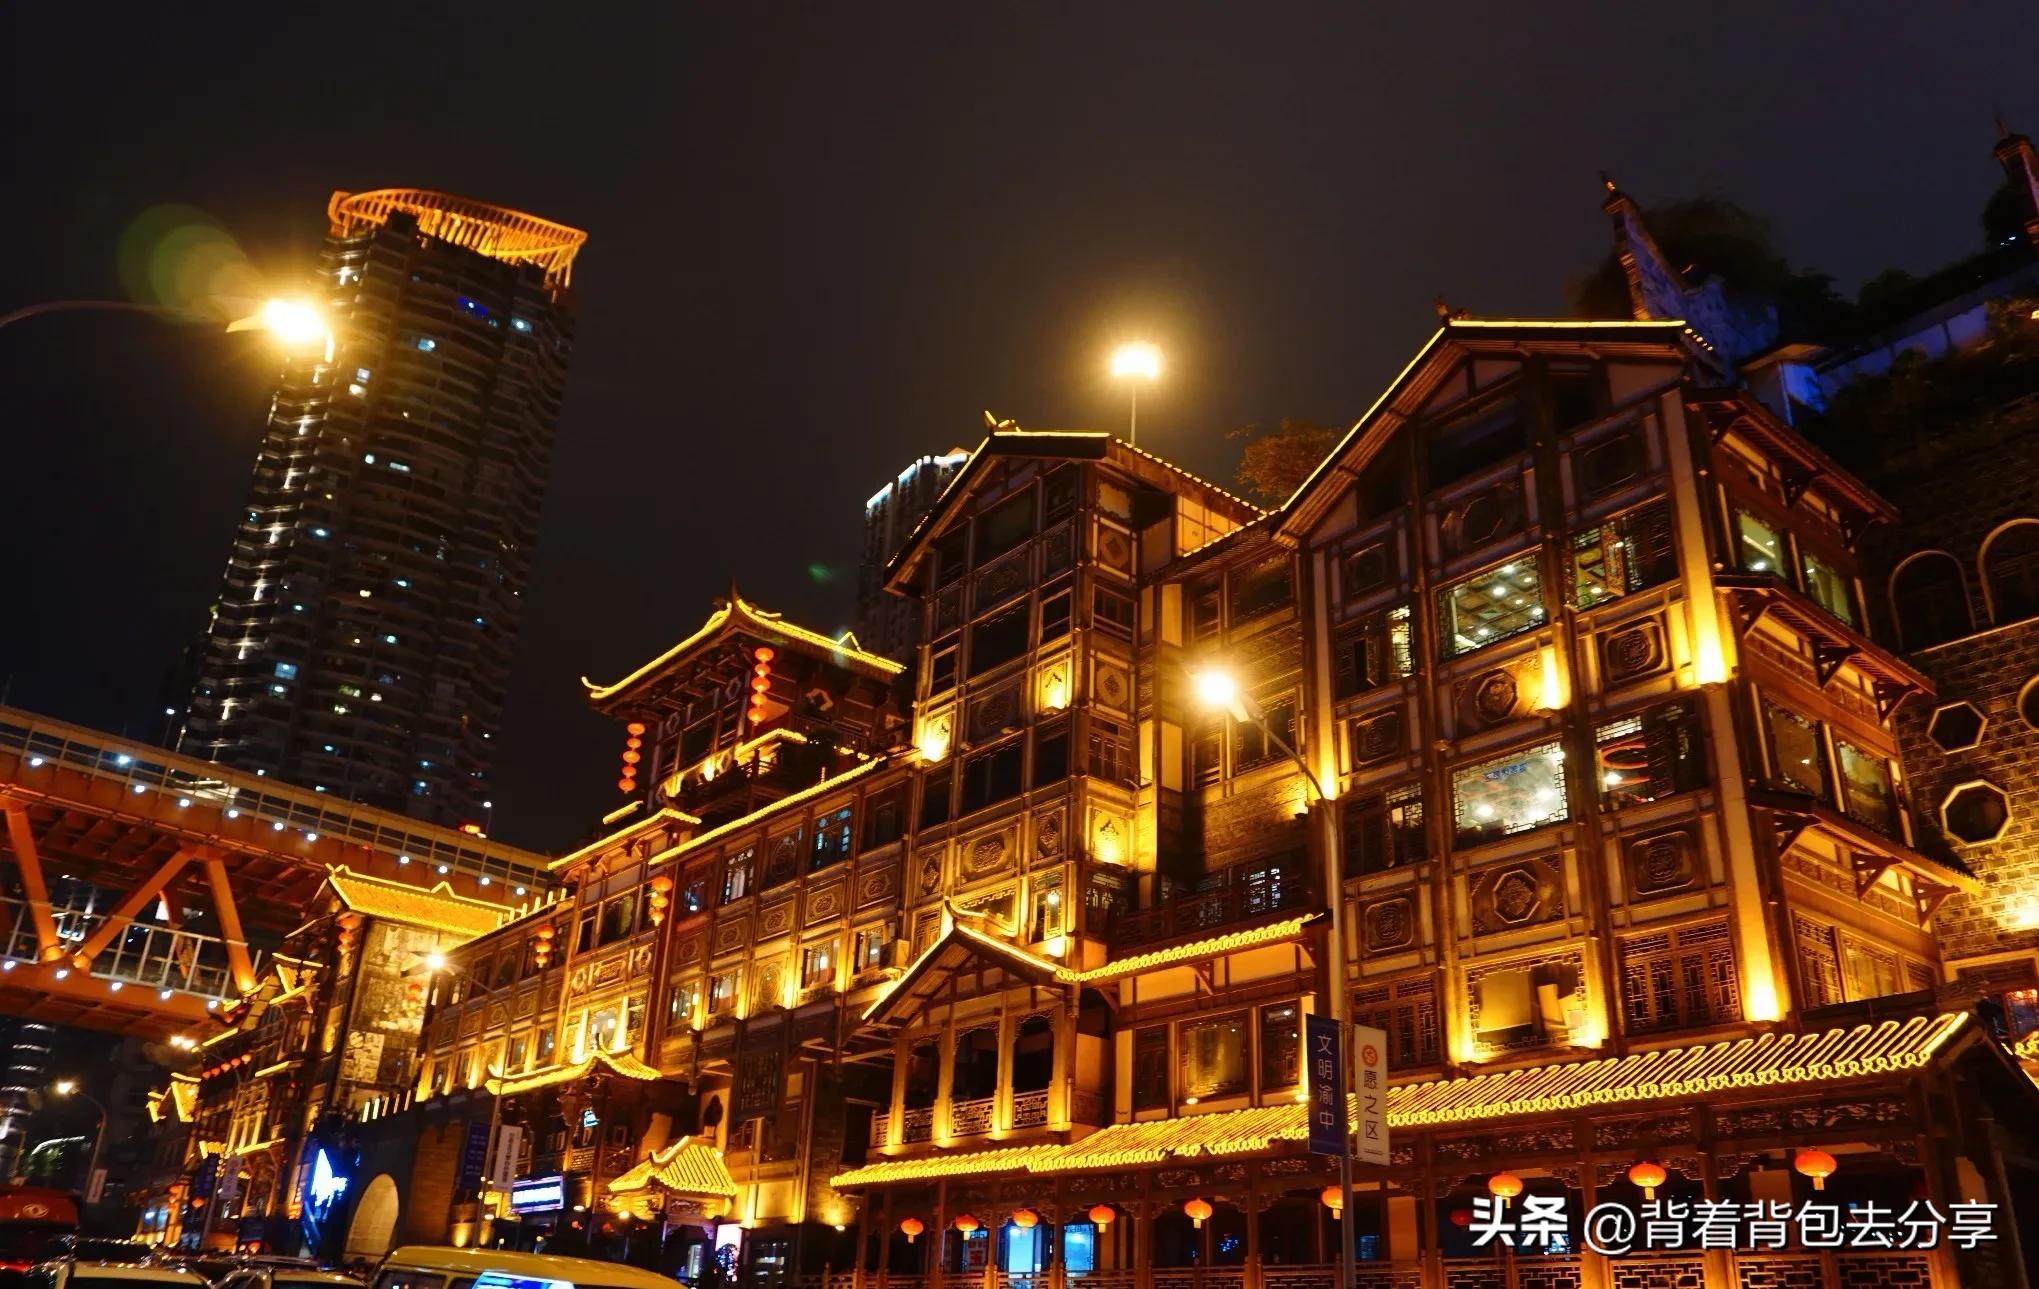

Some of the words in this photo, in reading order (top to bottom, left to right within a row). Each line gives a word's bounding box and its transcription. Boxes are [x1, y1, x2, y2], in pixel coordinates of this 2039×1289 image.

[1318, 1035, 1334, 1130] 文明渝中
[1364, 1071, 1379, 1140] 愿之区
